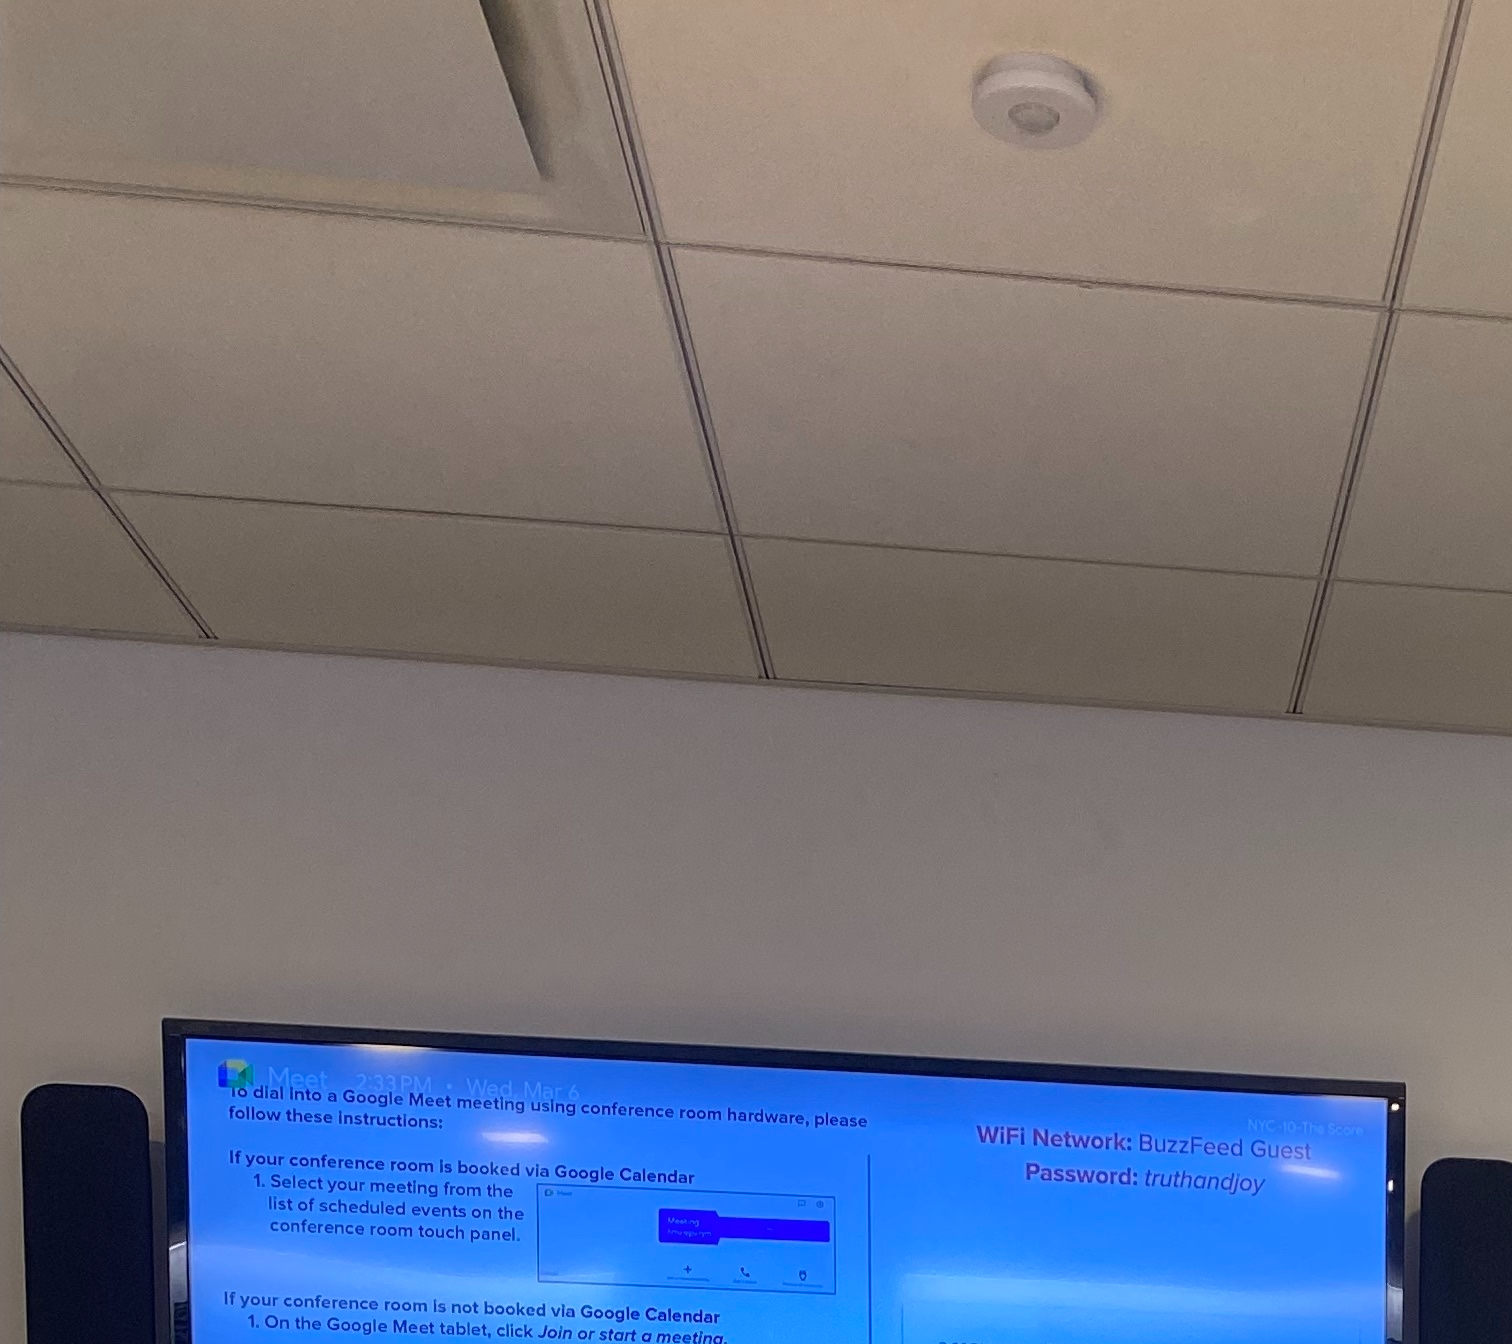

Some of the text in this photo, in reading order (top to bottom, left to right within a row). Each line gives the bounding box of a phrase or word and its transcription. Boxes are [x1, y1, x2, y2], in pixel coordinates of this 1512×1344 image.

[228, 1104, 442, 1129] follow these instructions:
[252, 1084, 867, 1128] dial into a Google Meet meeting using conference room hardware, please
[975, 1124, 1311, 1160] WiFi Network: BuzzFeed Guest
[229, 1149, 695, 1184] If your conference room is booked via Google Calendar
[1025, 1161, 1266, 1196] Password: truthandjoy
[252, 1172, 513, 1198] 1. Select your meeting from the
[268, 1195, 524, 1220] list of scheduled events on the
[269, 1218, 520, 1243] conference room touch panel.
[247, 1313, 259, 1328] 1.
[264, 1314, 289, 1329] On
[294, 1315, 321, 1330] the
[326, 1316, 387, 1335] Google
[392, 1318, 435, 1334] Meet
[438, 1320, 491, 1338] tablet,
[496, 1322, 533, 1338] click
[536, 1324, 572, 1340] Join
[576, 1329, 596, 1340] or
[598, 1327, 637, 1342] start
[640, 1331, 652, 1342] a
